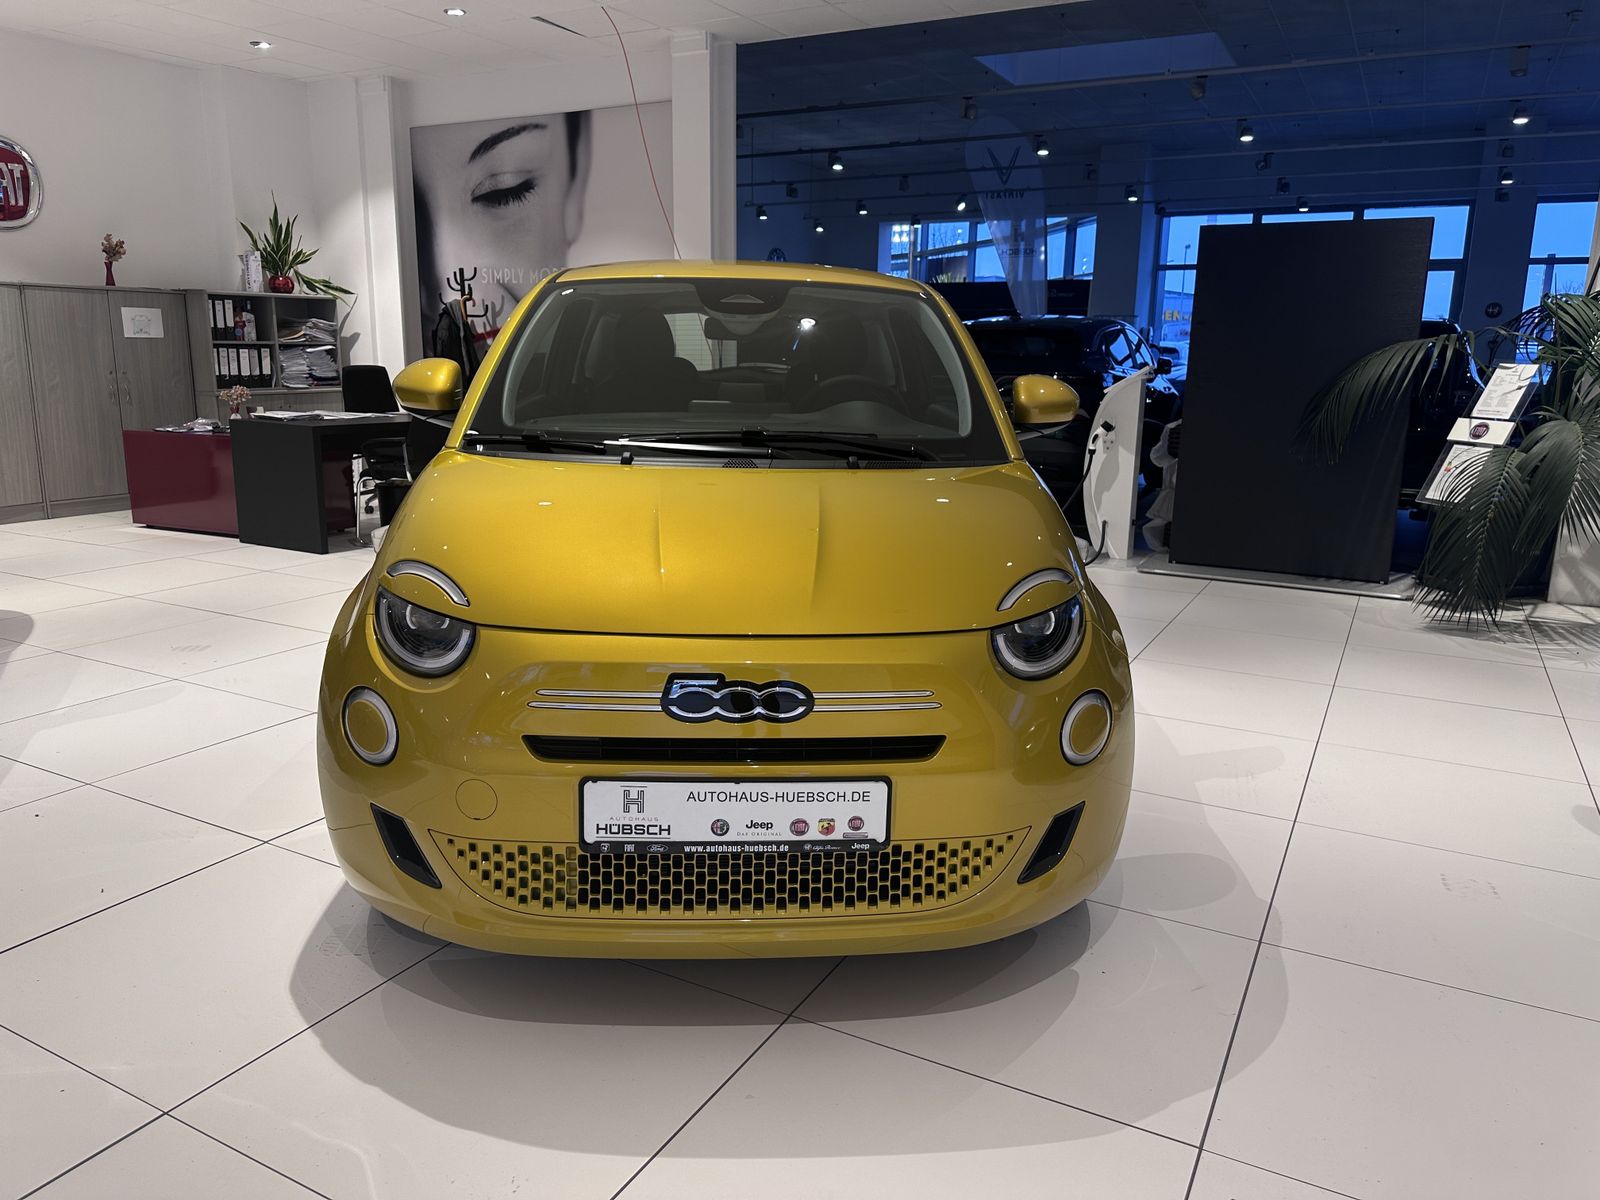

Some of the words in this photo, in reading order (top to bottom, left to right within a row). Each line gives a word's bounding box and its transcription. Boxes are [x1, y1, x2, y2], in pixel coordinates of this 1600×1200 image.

[0, 162, 24, 207] AT
[481, 268, 524, 284] SIMPLY
[664, 675, 812, 721] 500
[686, 791, 871, 803] AUTOHAUS-HUEBSCH.DE
[595, 823, 671, 836] HÜBSCH
[745, 819, 774, 831] Jeep
[683, 843, 790, 853] www.autohaus-huebsch.de
[851, 842, 871, 850] Jeep
